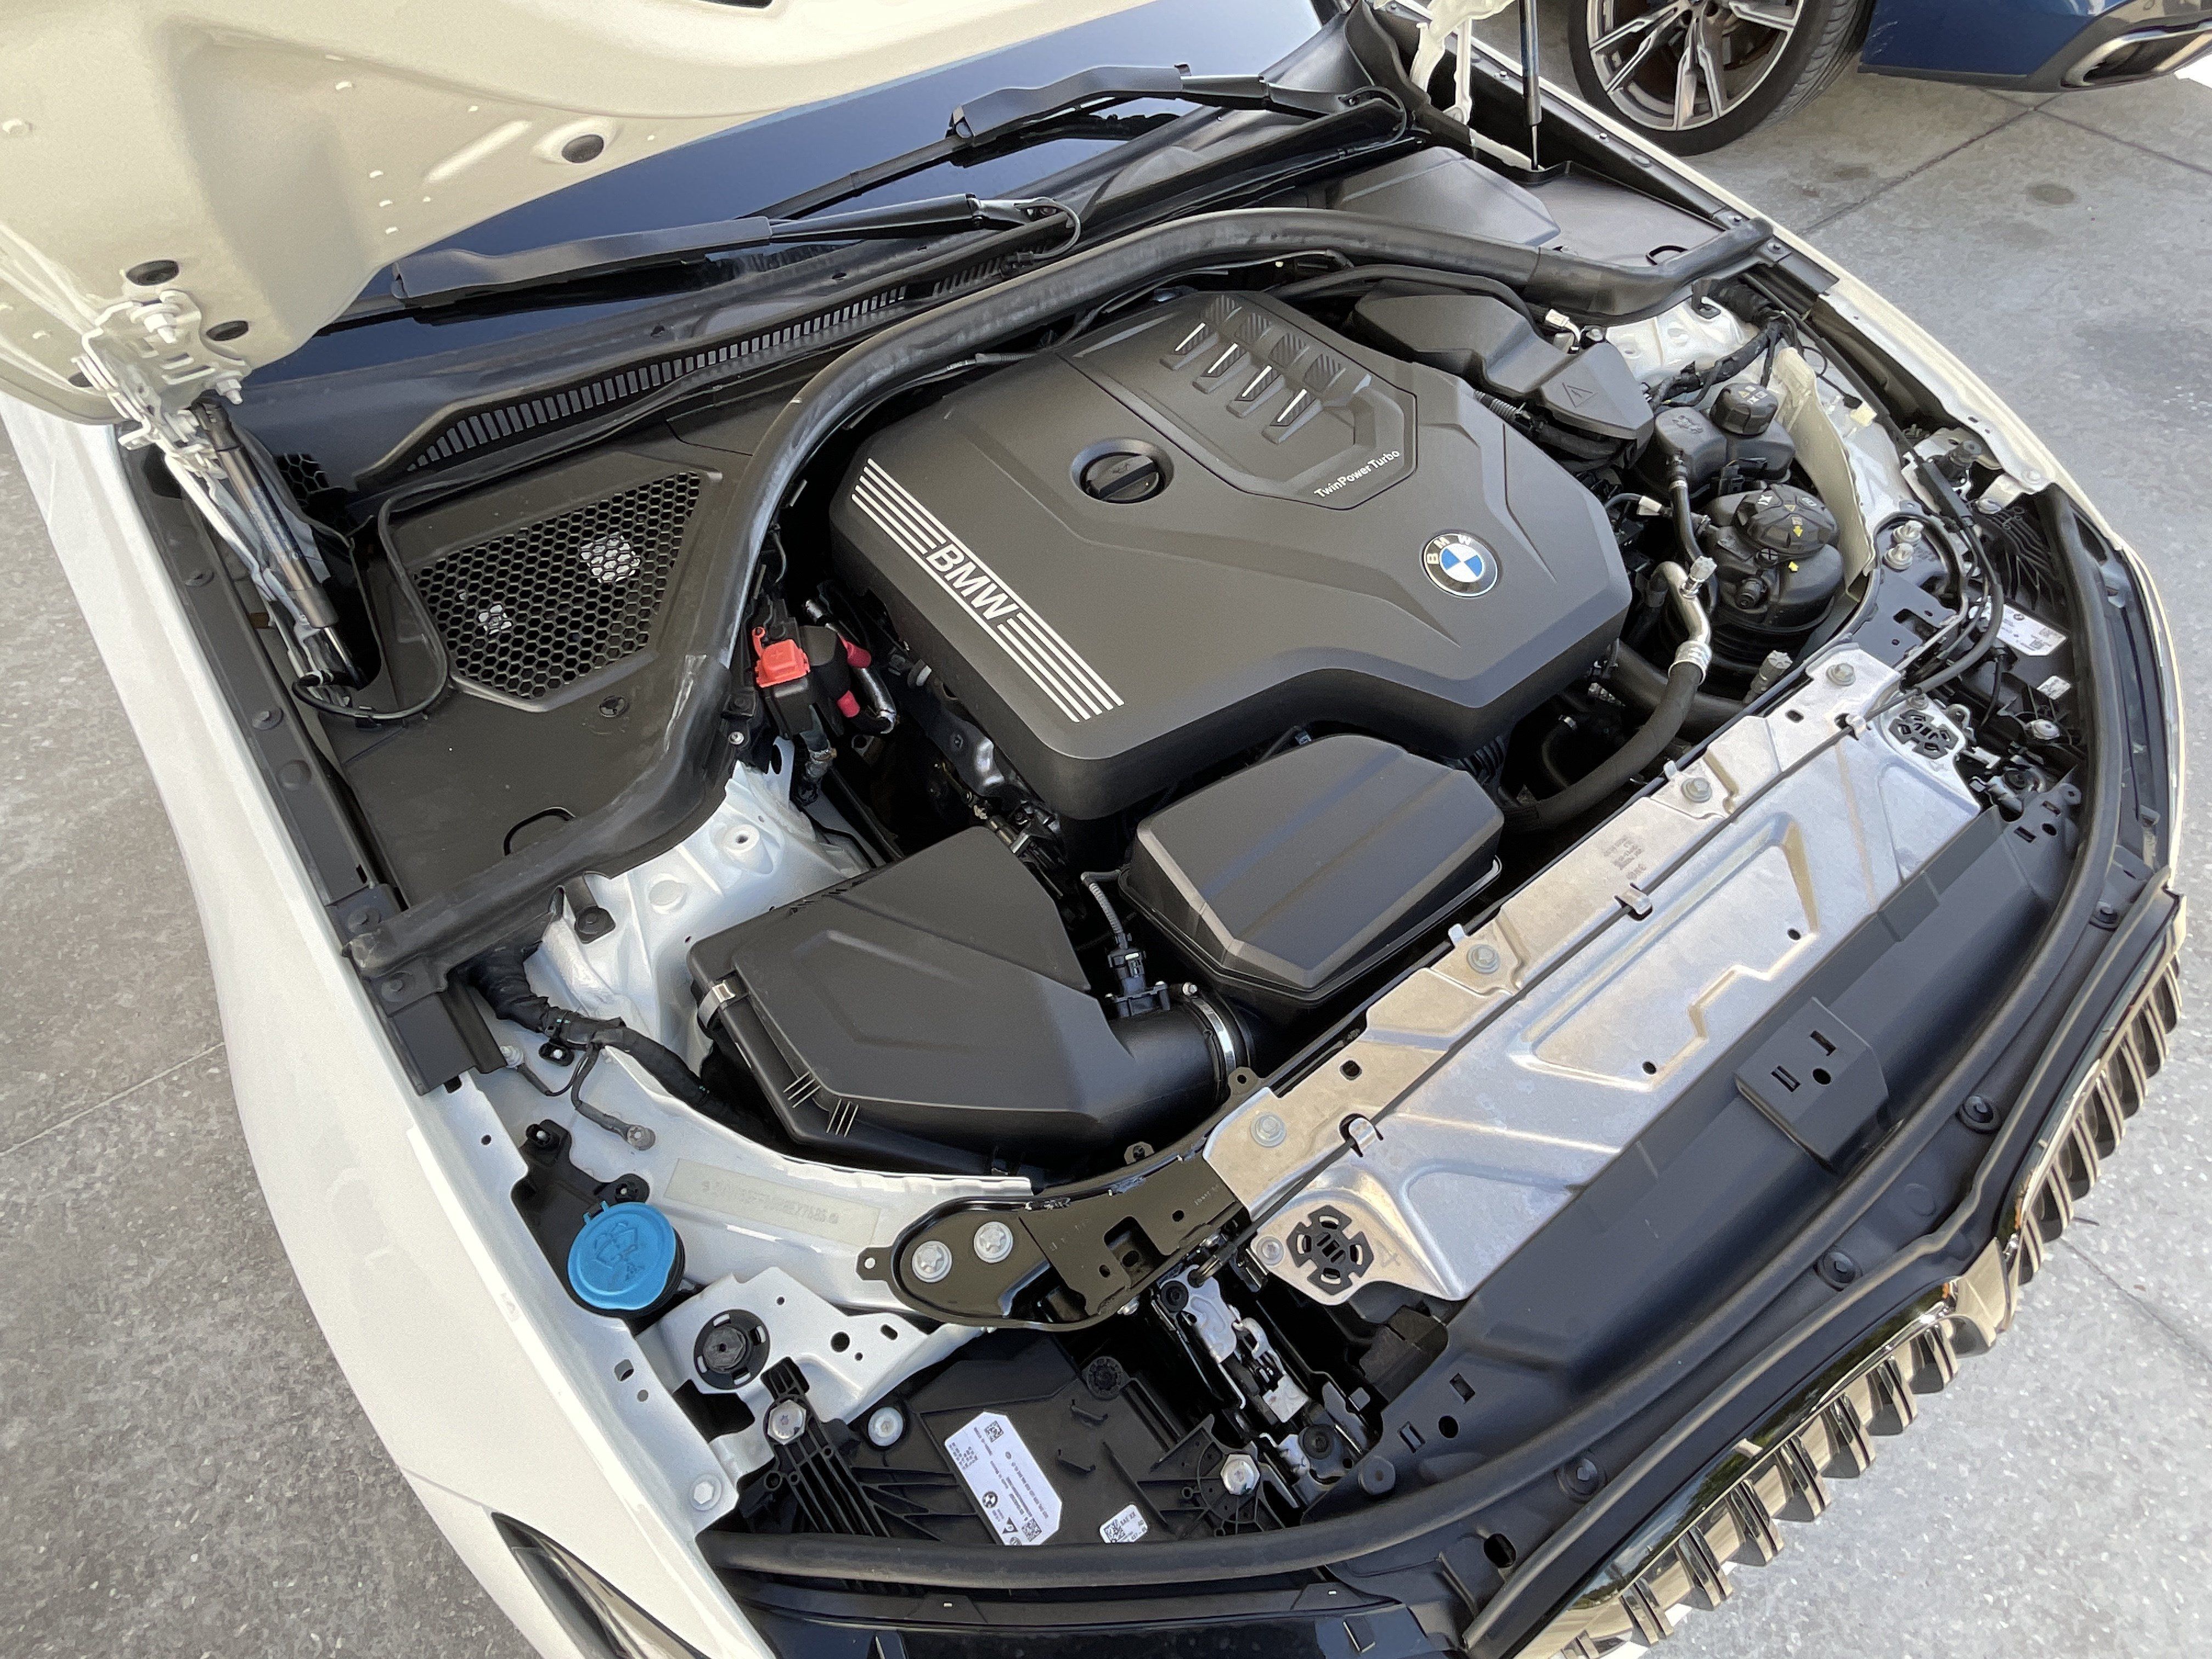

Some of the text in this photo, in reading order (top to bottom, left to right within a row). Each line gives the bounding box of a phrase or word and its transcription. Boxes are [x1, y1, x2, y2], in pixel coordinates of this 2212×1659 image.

[1313, 449, 1401, 498] TwinPower Turbo
[1426, 533, 1473, 565] BMW
[925, 543, 1019, 620] BMW
